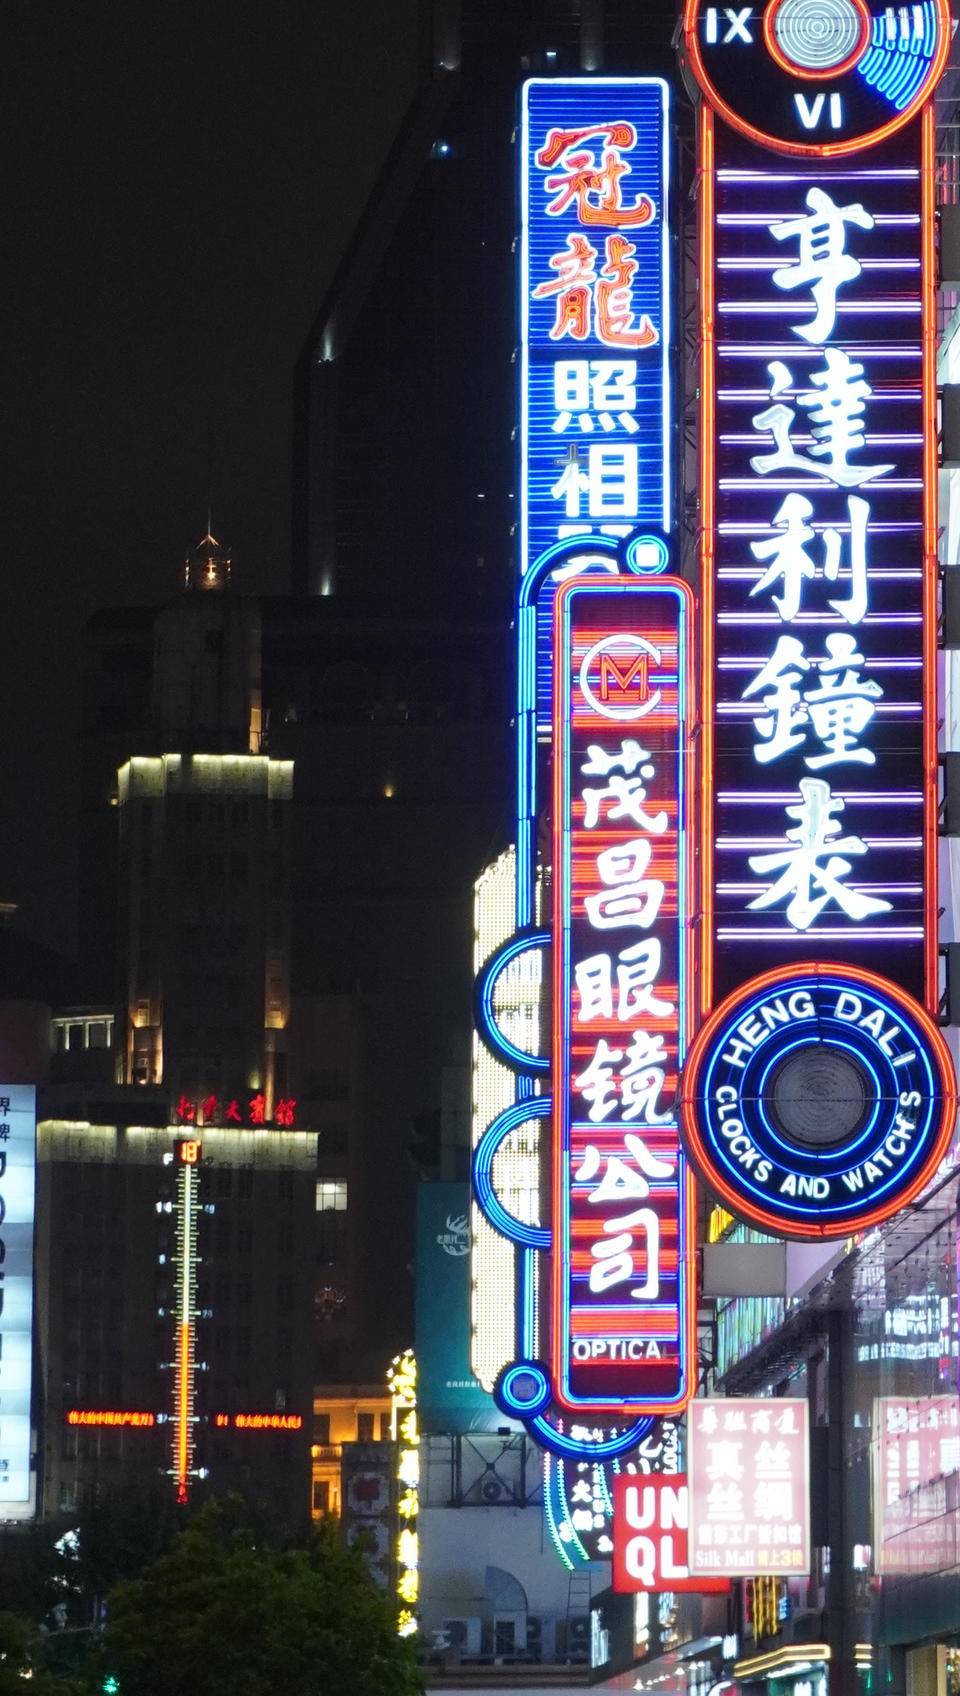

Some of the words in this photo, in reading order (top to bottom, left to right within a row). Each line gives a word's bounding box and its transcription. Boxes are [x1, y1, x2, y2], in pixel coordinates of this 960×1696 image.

[705, 7, 753, 43] IX
[794, 93, 842, 128] VI
[722, 991, 816, 1067] HENG
[833, 992, 916, 1067] DALI
[715, 1085, 773, 1182] CLOCKS
[780, 1174, 830, 1198] AND
[626, 1486, 689, 1529] UN
[626, 1536, 689, 1586] QL
[696, 1549, 722, 1567] Silk
[725, 1549, 755, 1567] Mall
